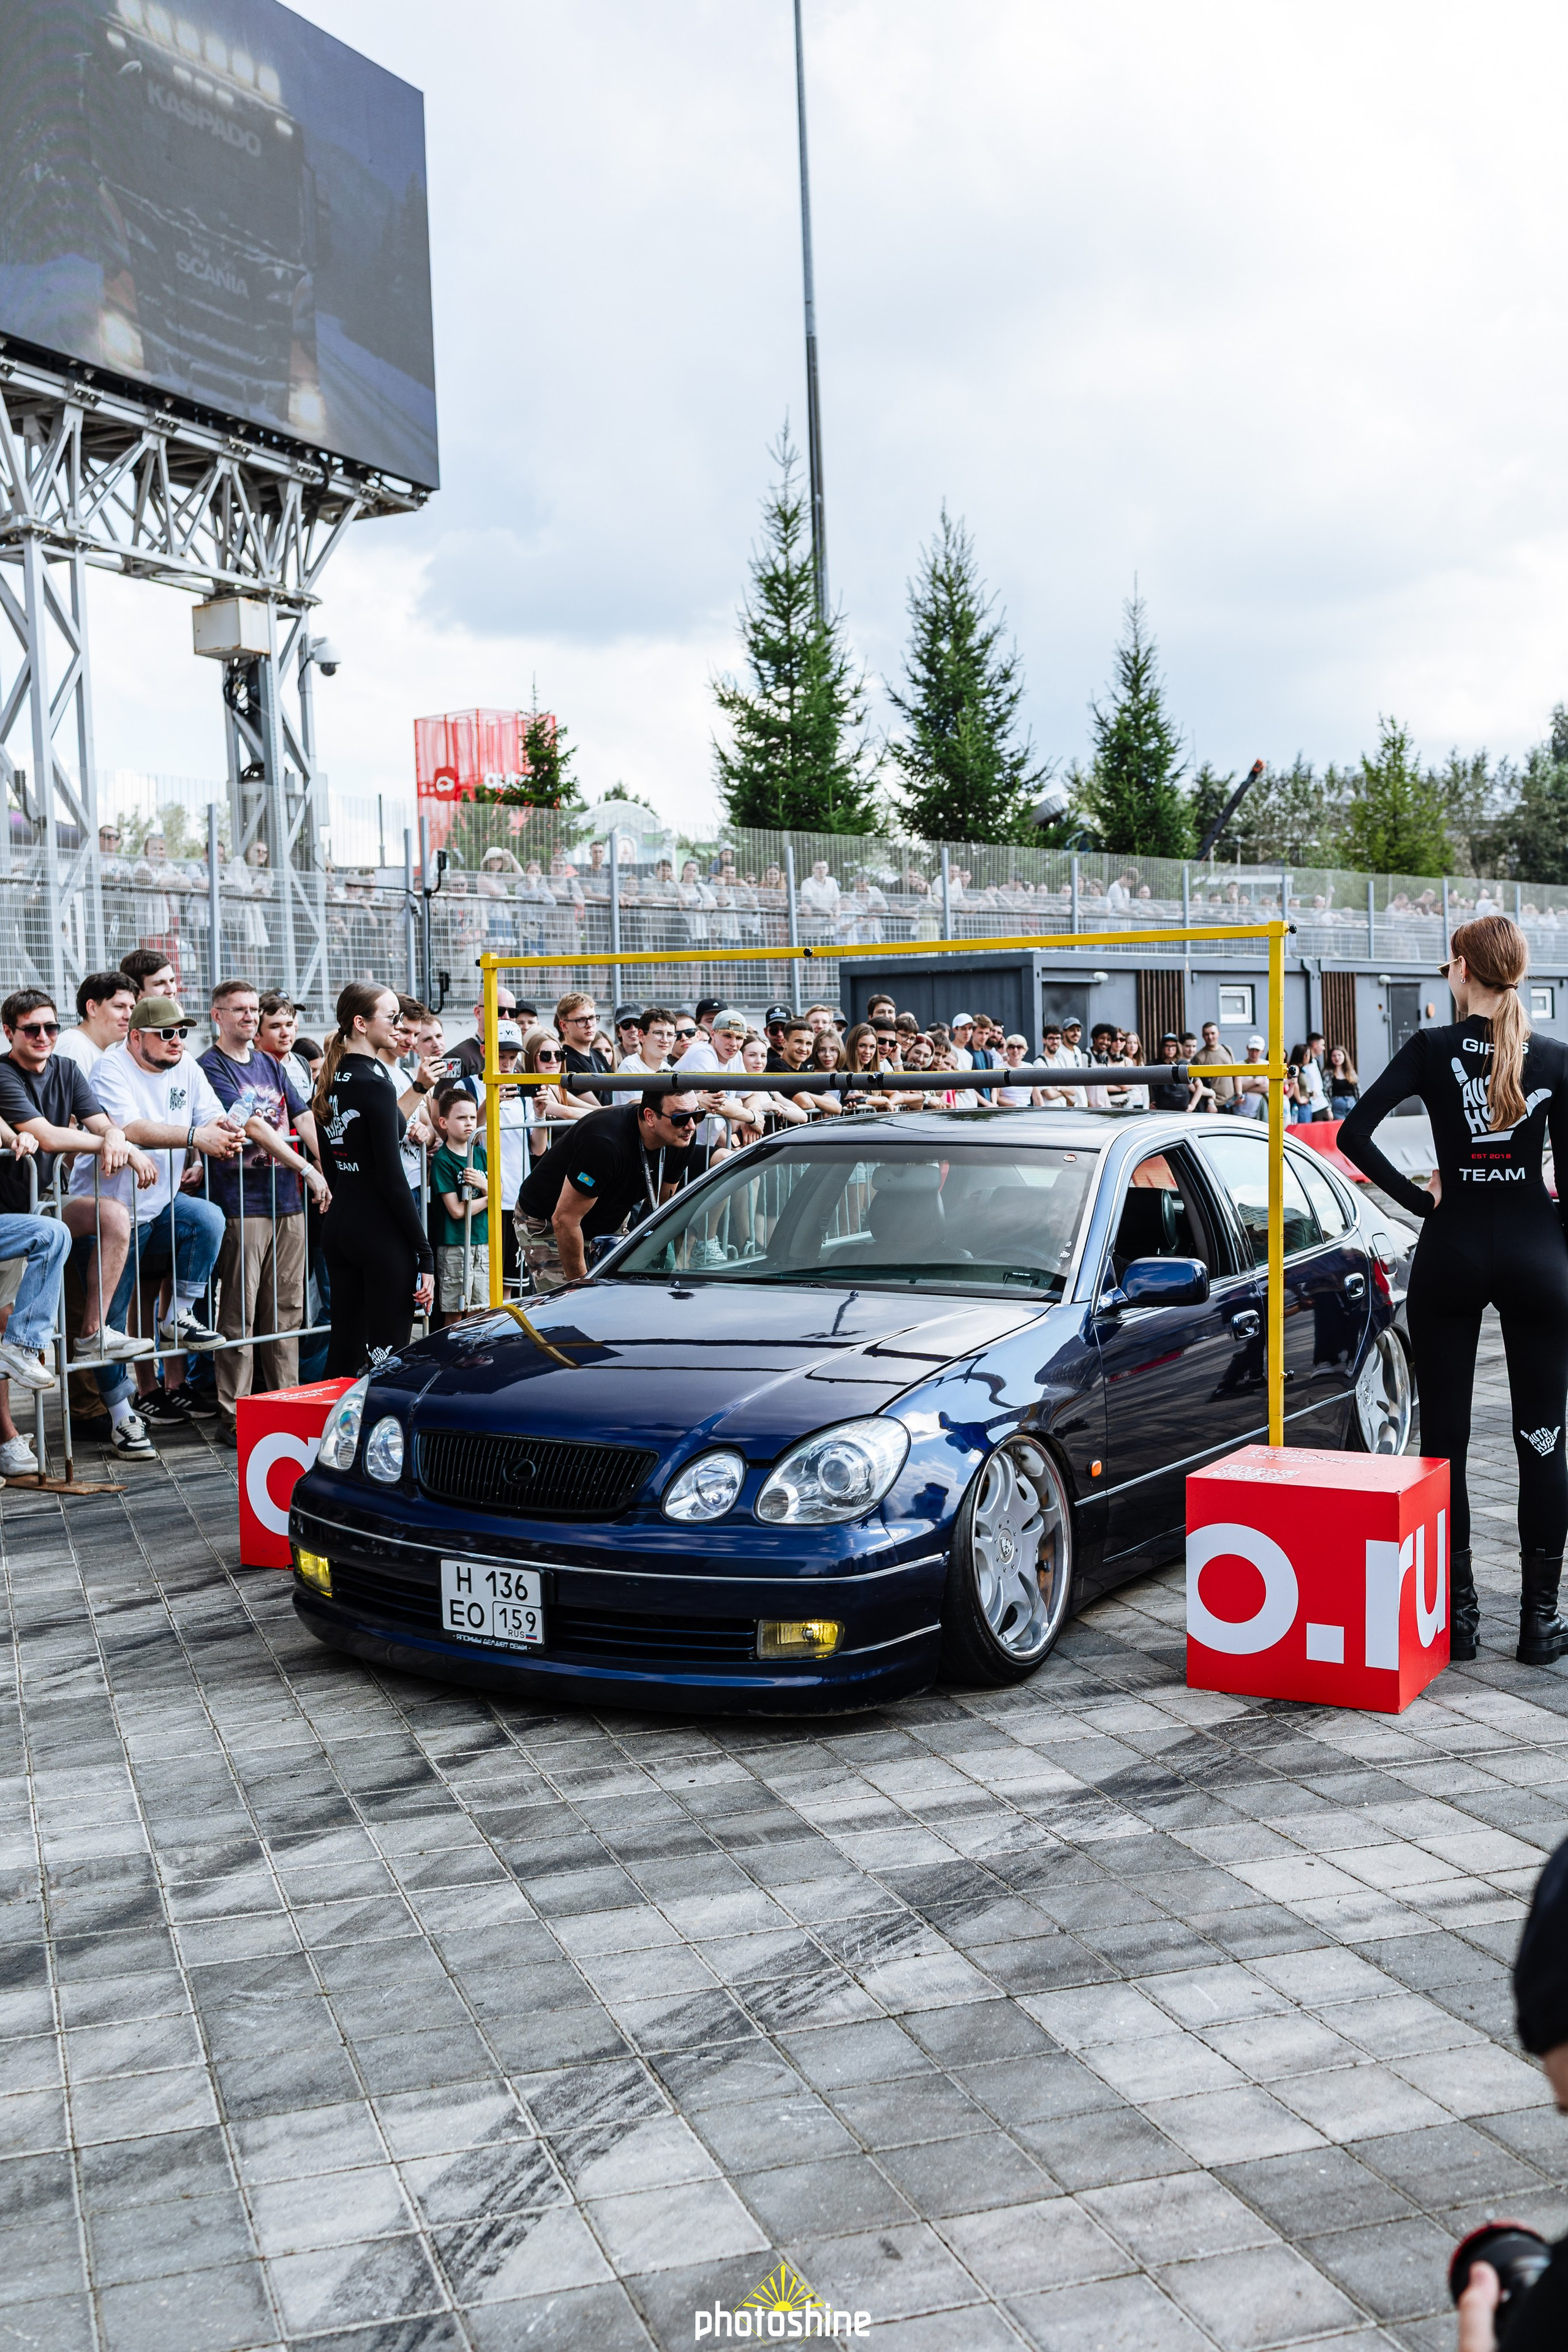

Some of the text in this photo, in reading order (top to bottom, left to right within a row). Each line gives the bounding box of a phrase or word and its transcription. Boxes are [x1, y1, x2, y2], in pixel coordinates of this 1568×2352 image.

[175, 251, 249, 300] SCANIA
[335, 1160, 360, 1172] TEAM
[1459, 1167, 1526, 1182] TEAM
[1529, 1427, 1548, 1446] AUTO
[1534, 1434, 1556, 1453] HYPE
[485, 1570, 528, 1600] 136
[499, 1608, 537, 1632] 159
[508, 1629, 525, 1638] RUS
